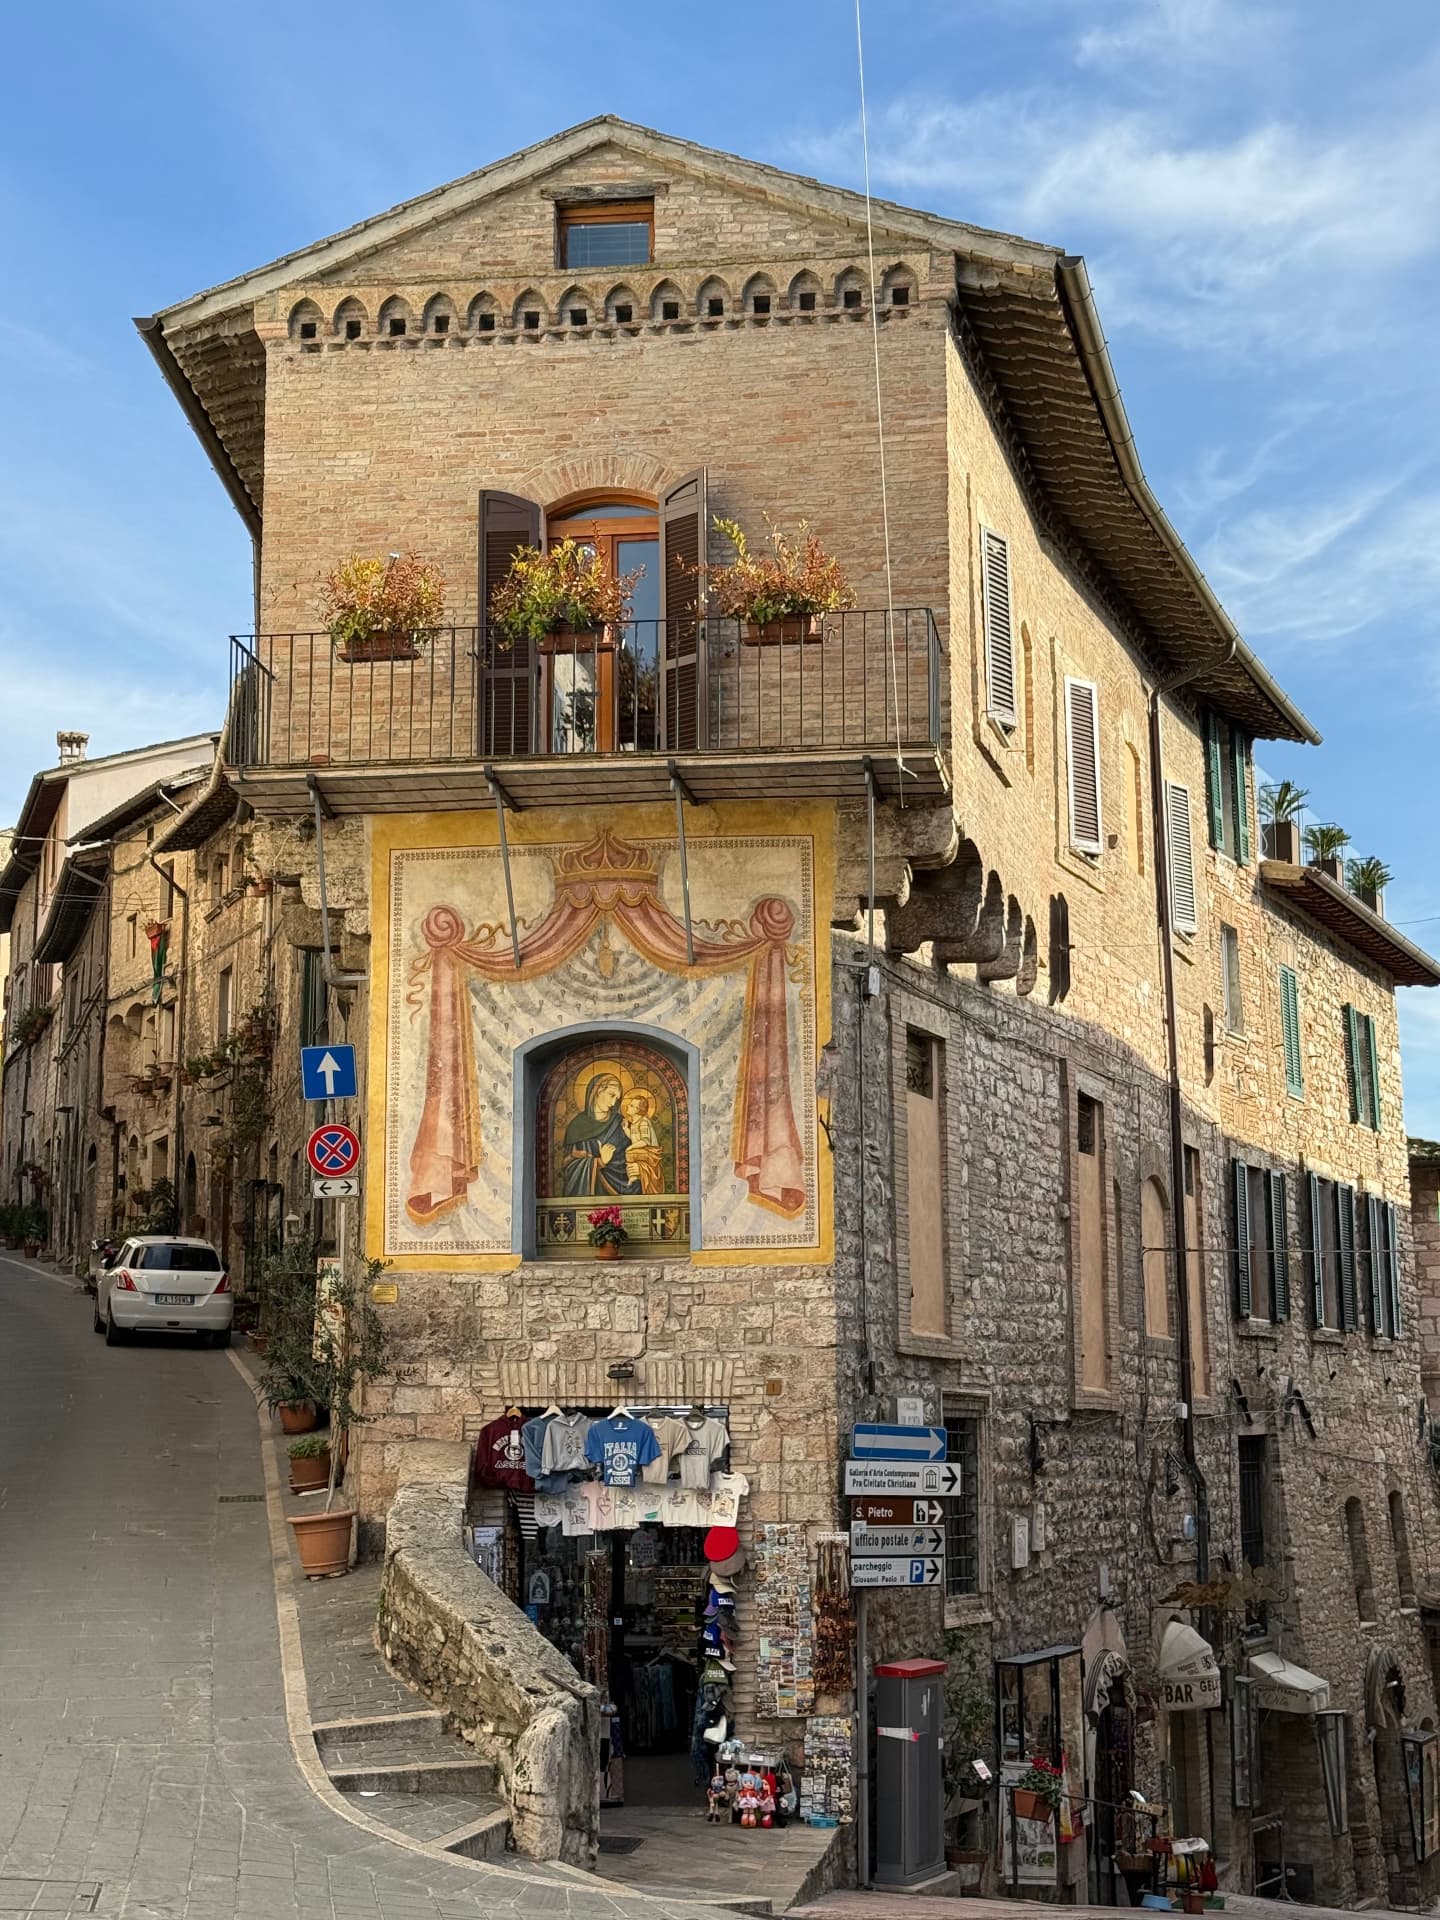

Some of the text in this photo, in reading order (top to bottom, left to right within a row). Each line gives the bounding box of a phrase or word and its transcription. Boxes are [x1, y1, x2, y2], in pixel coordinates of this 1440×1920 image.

[604, 1442, 637, 1459] ITALIA
[852, 1478, 917, 1489] Pro Civitate Christiana
[855, 1507, 893, 1518] S. Pietro
[855, 1534, 879, 1546] ufficio
[881, 1533, 908, 1549] postale
[853, 1562, 892, 1572] parcheggio
[853, 1575, 879, 1584] Giovanni
[881, 1575, 897, 1583] Paolo
[1165, 1684, 1193, 1703] BAR
